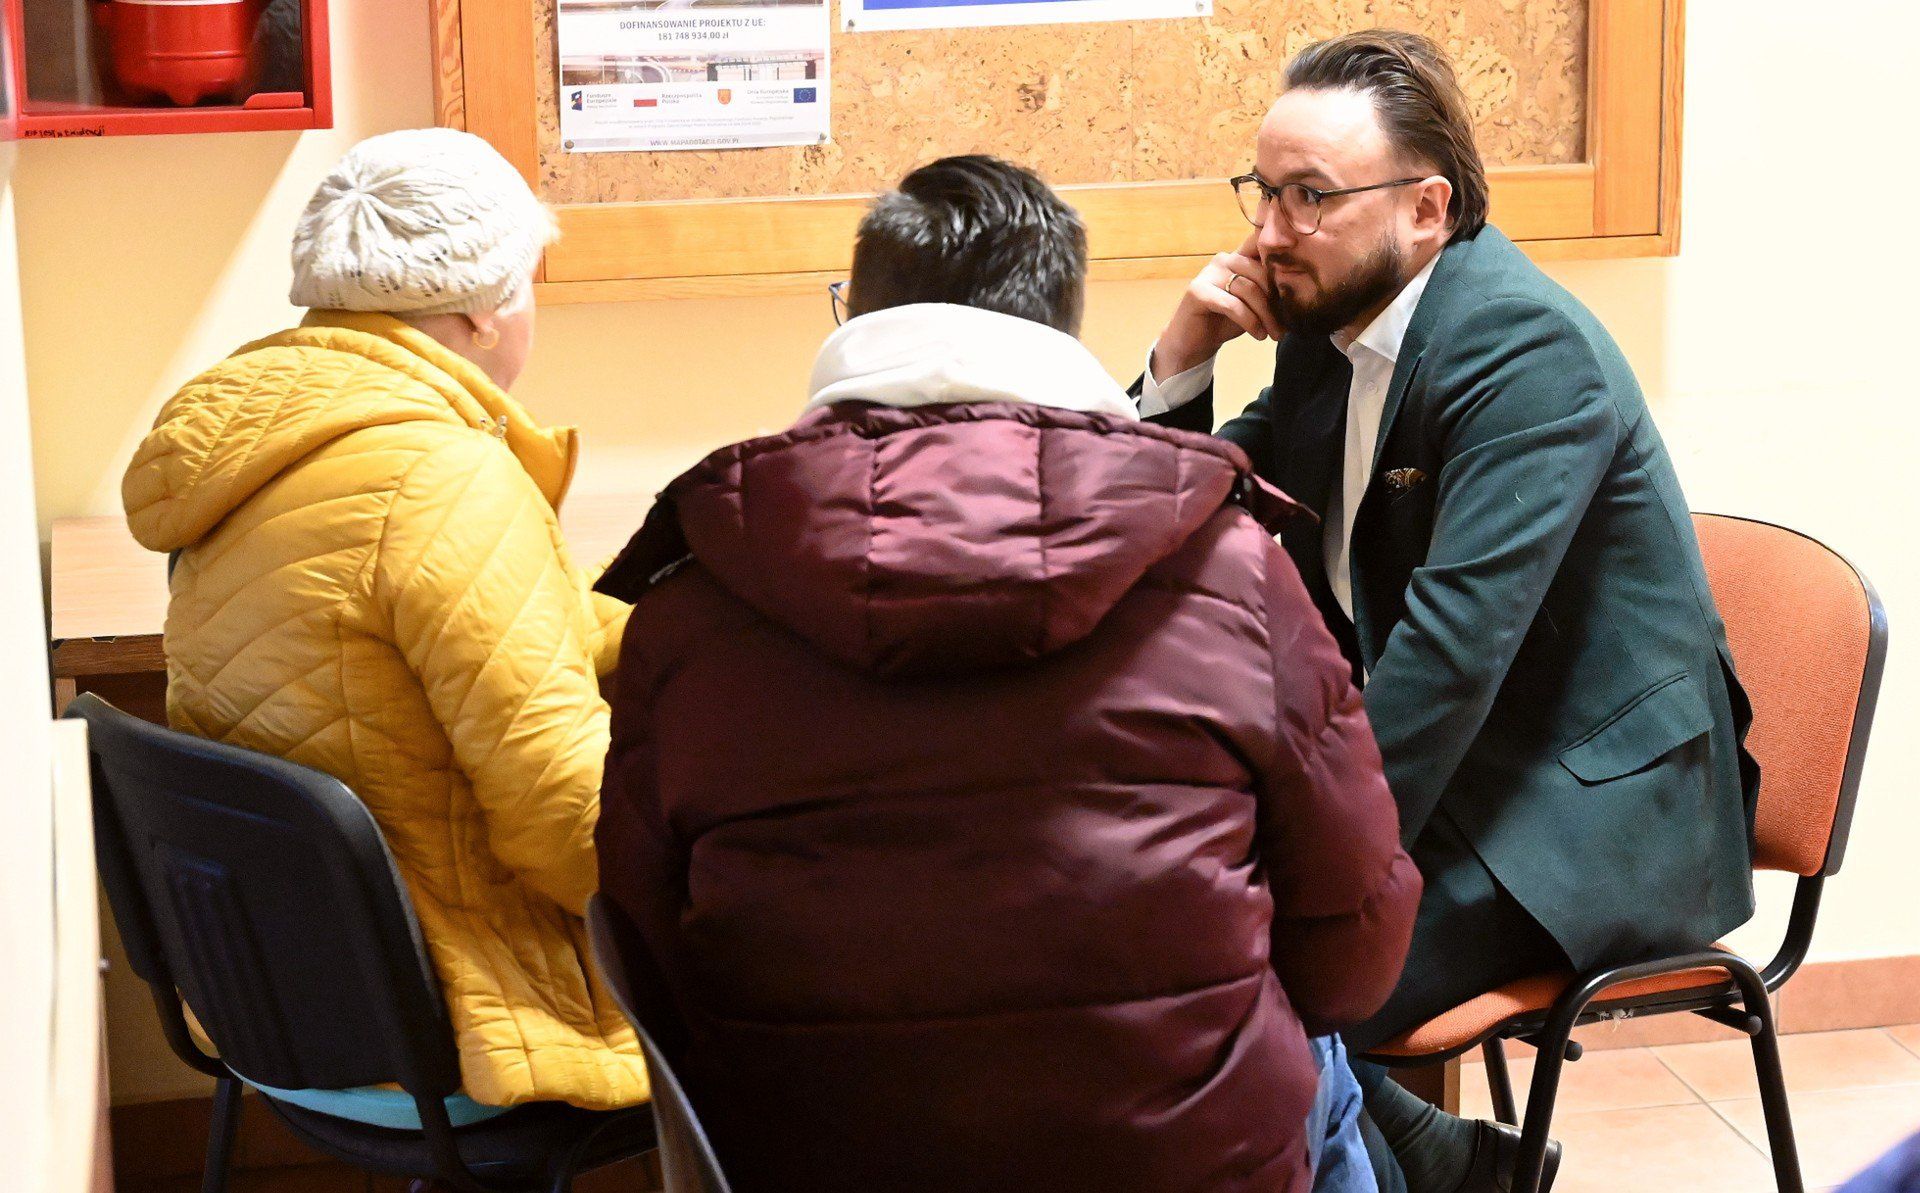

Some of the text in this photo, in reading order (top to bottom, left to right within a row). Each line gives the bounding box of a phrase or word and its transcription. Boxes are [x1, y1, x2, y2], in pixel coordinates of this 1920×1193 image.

[619, 18, 766, 30] DOFINANSOWANIE PROJEKTU Z UE:
